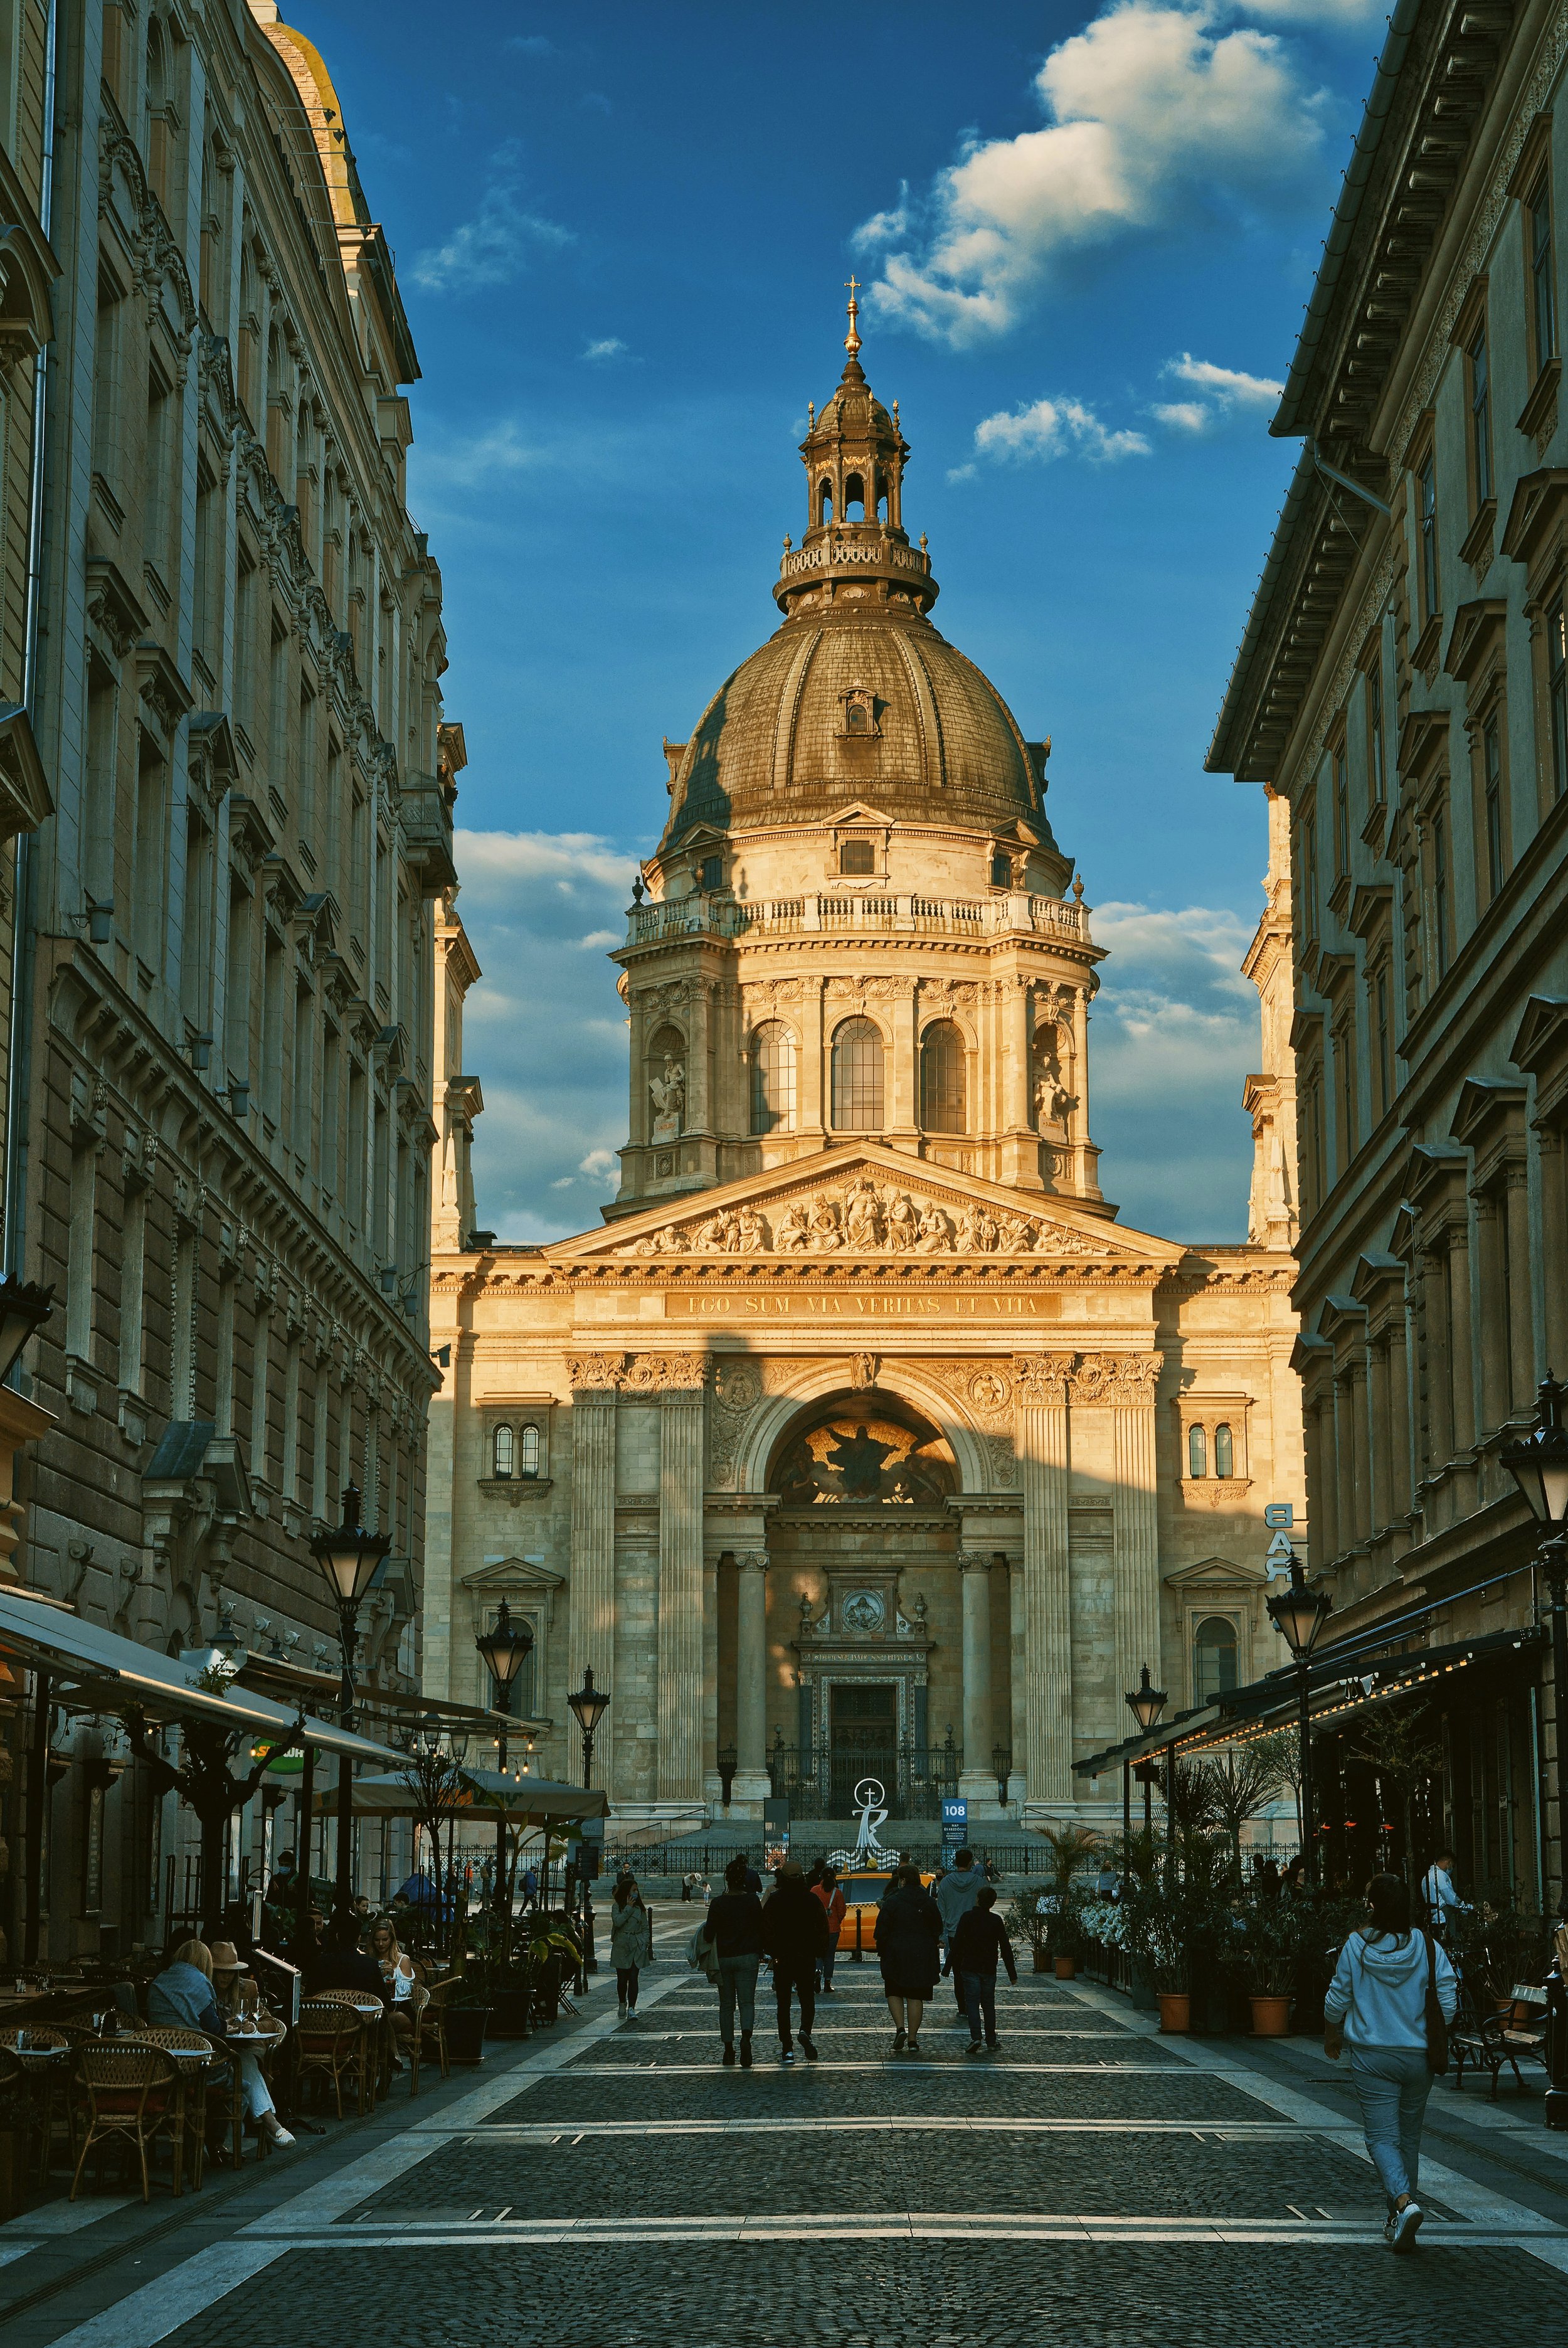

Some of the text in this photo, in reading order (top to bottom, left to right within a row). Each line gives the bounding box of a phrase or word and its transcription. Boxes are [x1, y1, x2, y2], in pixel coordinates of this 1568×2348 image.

[688, 1297, 1038, 1314] EGO SUM VIA VERITAS ET VITA
[945, 1805, 965, 1816] 108
